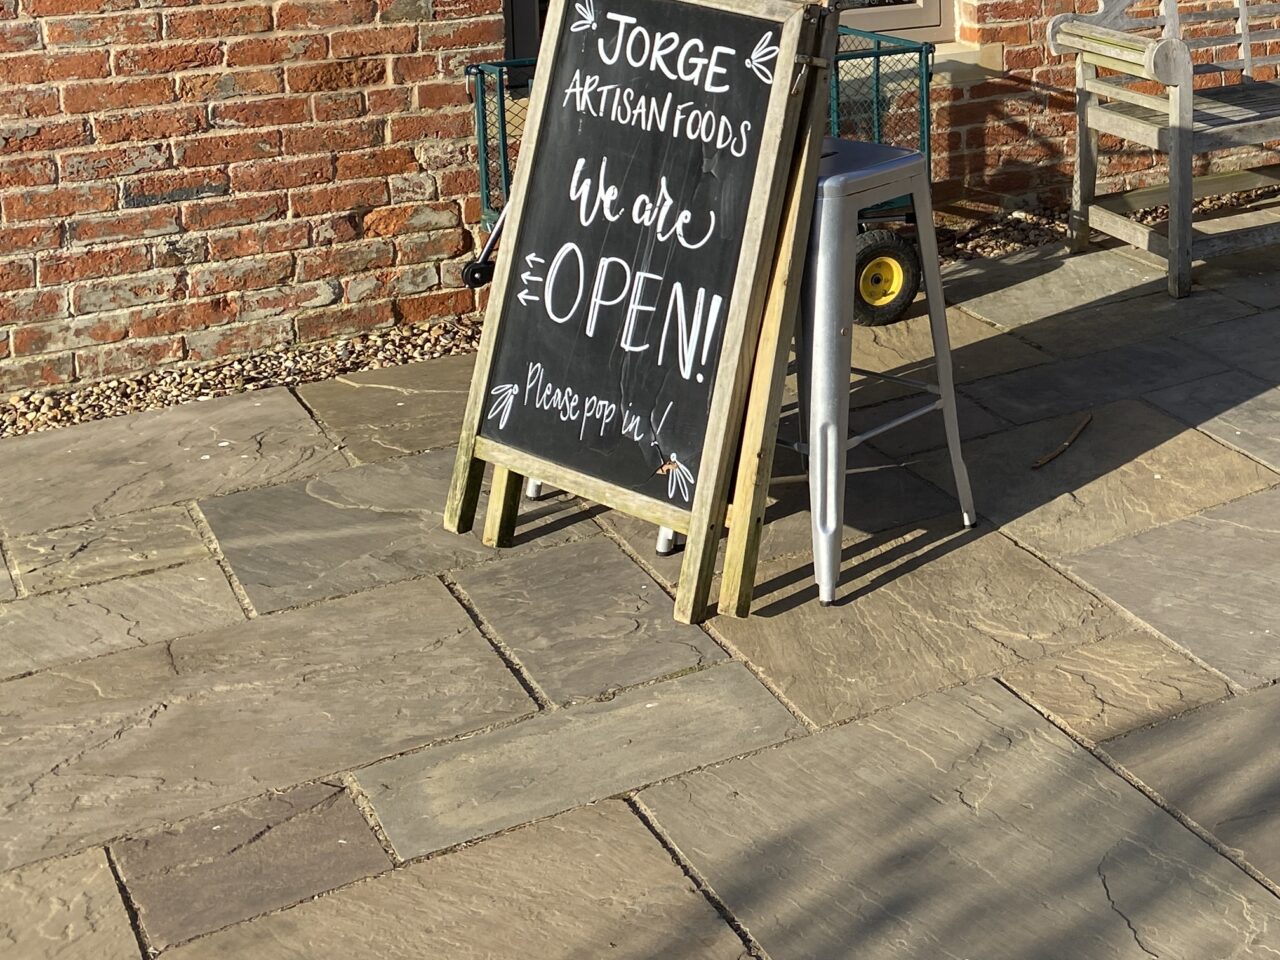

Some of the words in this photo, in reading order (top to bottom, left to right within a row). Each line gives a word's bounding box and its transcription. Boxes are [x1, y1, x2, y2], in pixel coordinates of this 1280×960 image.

[597, 11, 736, 93] JORGE
[562, 68, 673, 132] ARTISAN
[673, 101, 751, 158] FOODS
[570, 156, 625, 227] We
[631, 176, 716, 250] are
[544, 241, 723, 383] OPEN!
[523, 361, 580, 422] Please
[579, 397, 616, 441] pop
